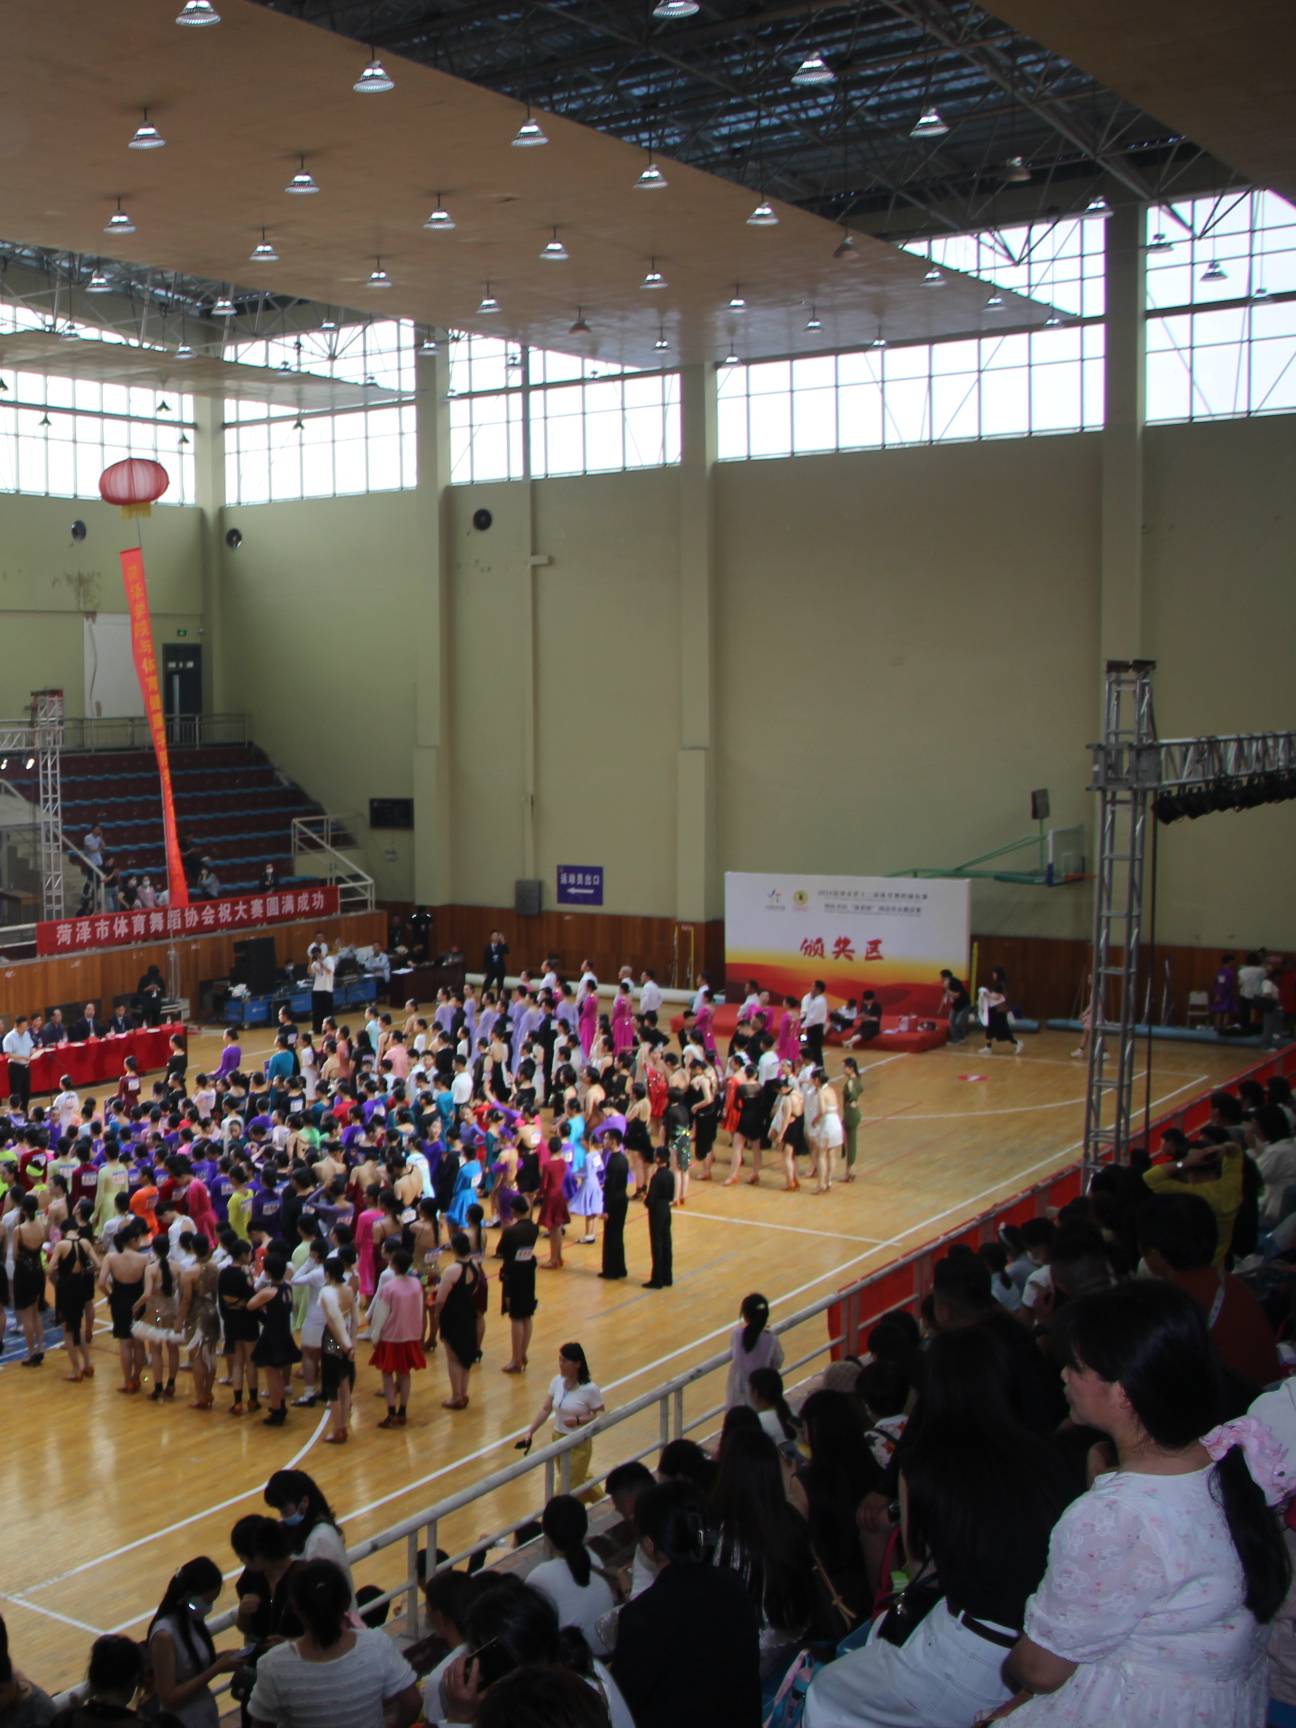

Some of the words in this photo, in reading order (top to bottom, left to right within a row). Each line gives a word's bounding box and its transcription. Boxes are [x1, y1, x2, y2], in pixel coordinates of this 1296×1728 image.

[55, 893, 325, 946] 菏泽市体育舞蹈协会祝大赛圆满成功
[799, 935, 885, 962] 颁奖区
